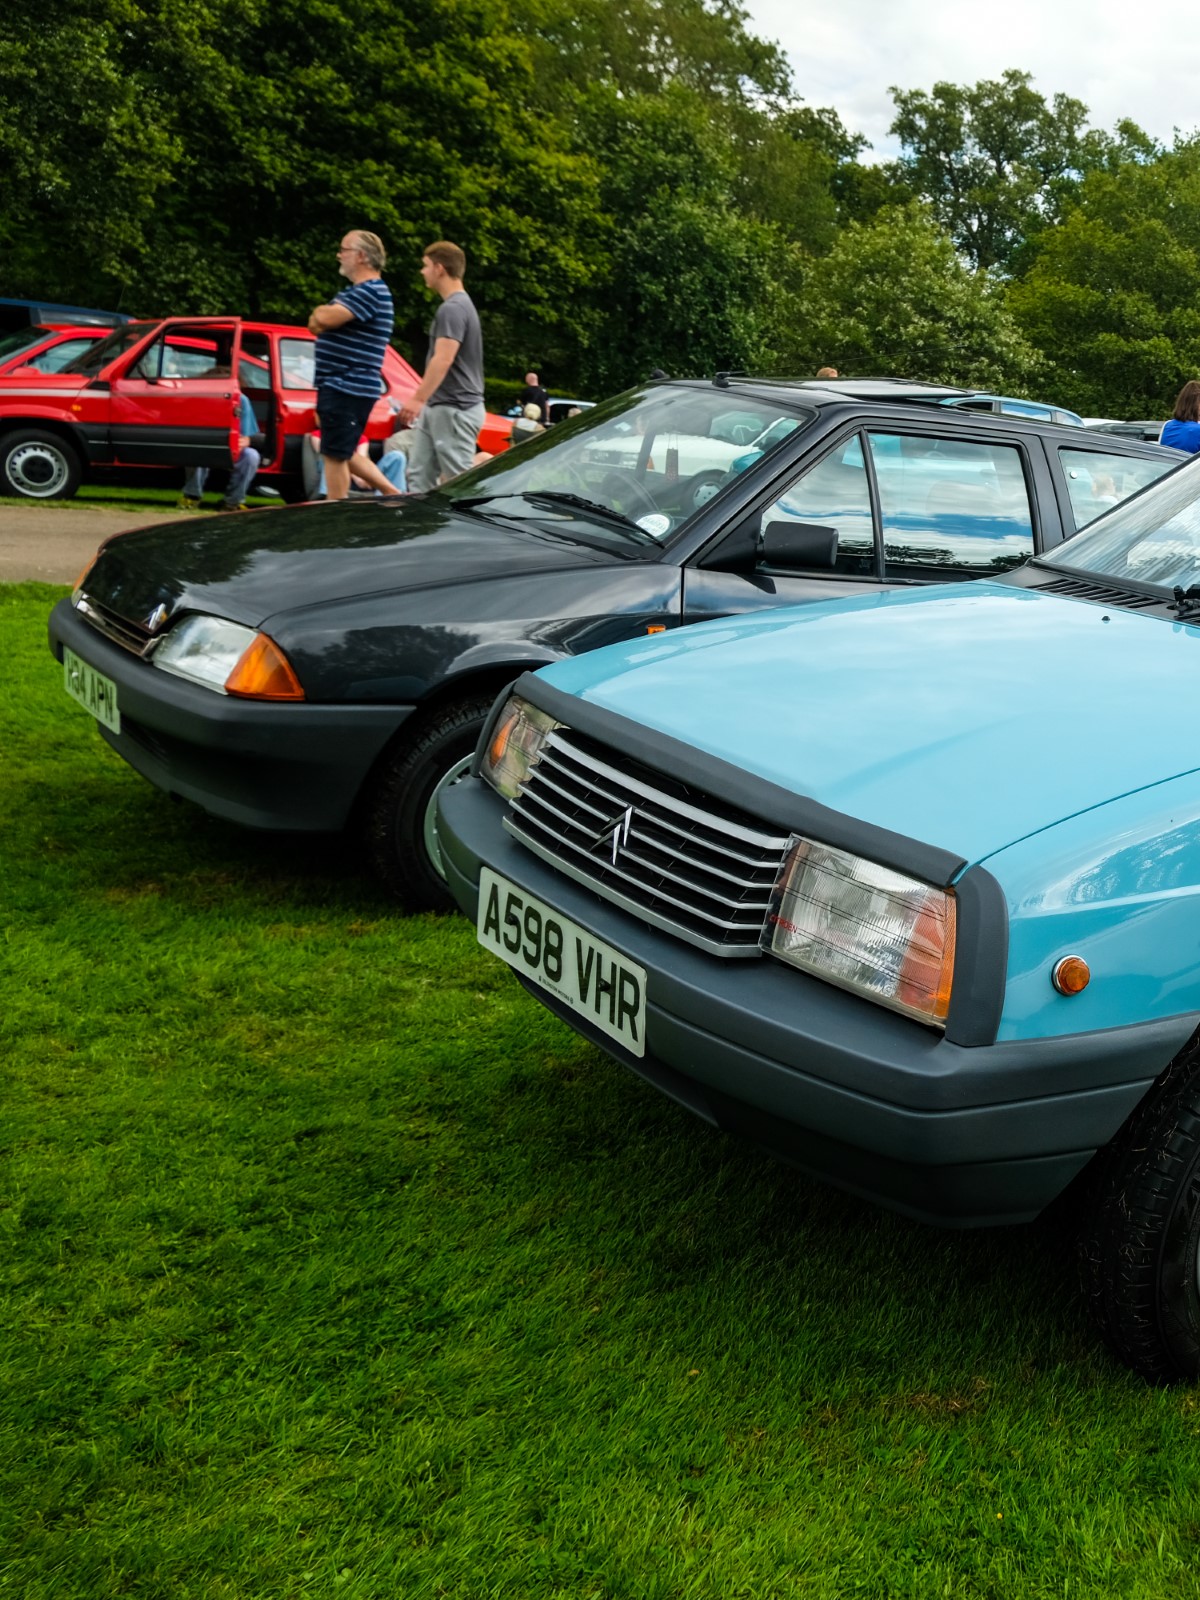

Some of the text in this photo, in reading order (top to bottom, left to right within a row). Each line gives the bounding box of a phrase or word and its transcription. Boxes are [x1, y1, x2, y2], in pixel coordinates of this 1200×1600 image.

[90, 672, 113, 723] APN
[483, 882, 641, 1043] A598 VHR
